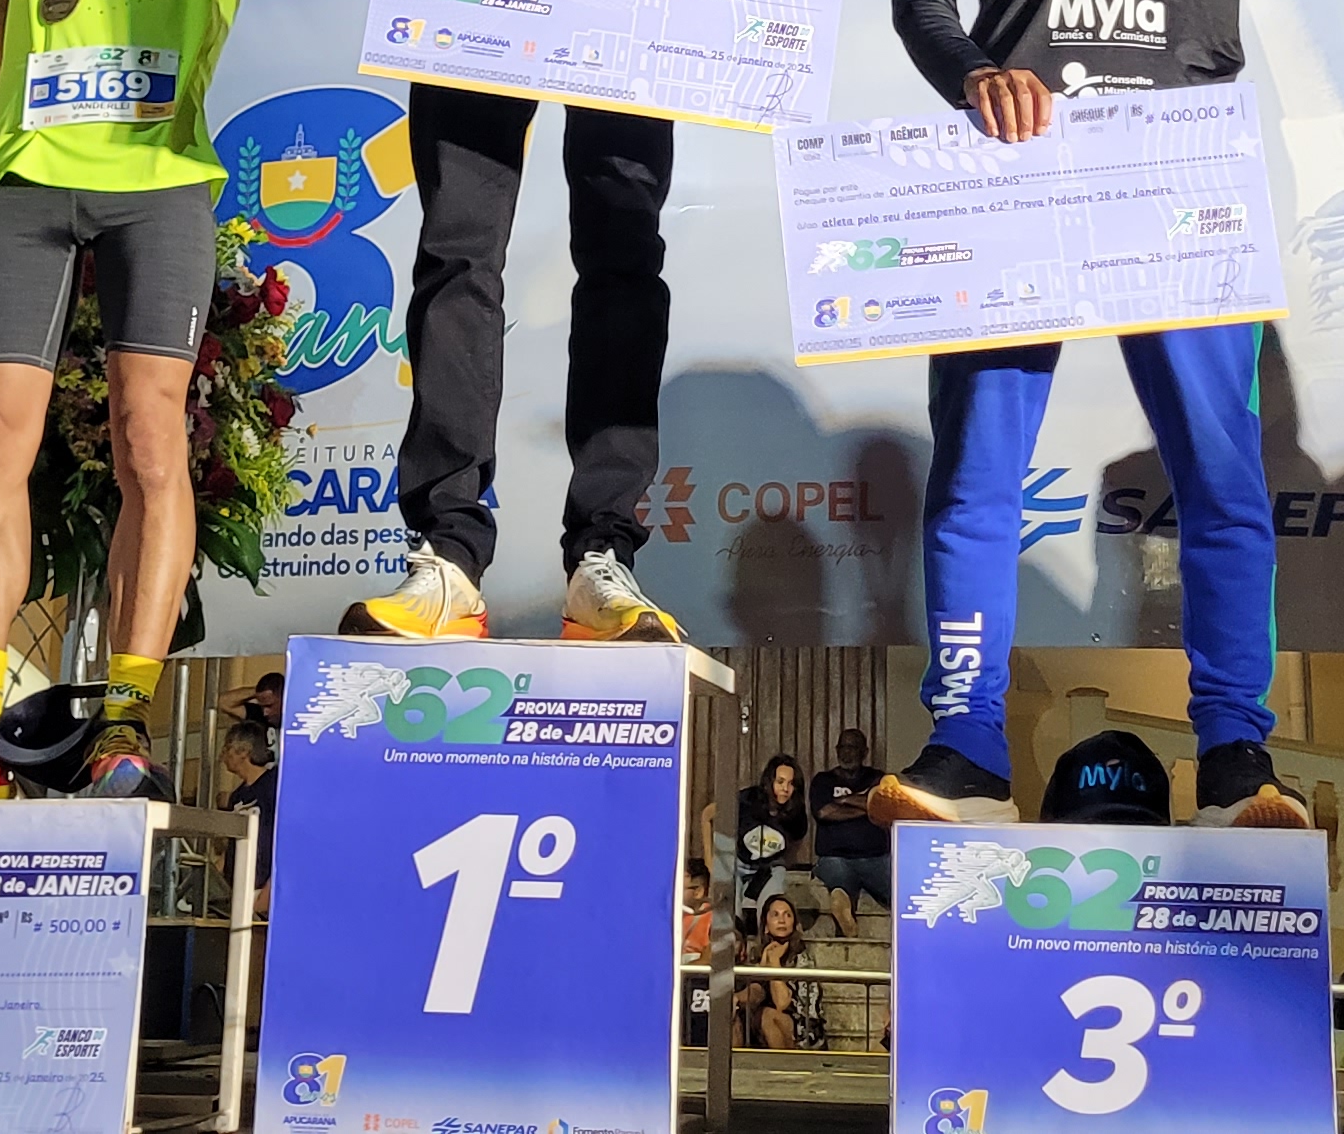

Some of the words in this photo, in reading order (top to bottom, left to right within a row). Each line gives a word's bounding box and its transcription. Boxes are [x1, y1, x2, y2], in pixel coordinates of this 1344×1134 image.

[505, 0, 550, 14] JANEIRO
[767, 22, 799, 36] BANCO
[1052, 29, 1084, 40] Bonés
[1085, 32, 1093, 40] e
[1113, 30, 1167, 44] Camisetas
[457, 33, 511, 48] APUCARANA
[764, 36, 807, 51] ESPORTE
[647, 41, 706, 59] Apucarana,
[711, 50, 725, 60] 25
[737, 54, 773, 68] janeiro
[56, 70, 150, 101] 5169
[1104, 75, 1153, 85] Conselho
[72, 102, 130, 110] VANDERLEI
[1160, 106, 1219, 124] 400,00
[797, 137, 824, 150] COMP
[841, 133, 871, 146] BANCO
[890, 126, 928, 141] AGÊNCIA
[889, 179, 983, 197] QUATROCENTOS
[822, 218, 854, 229] atleta
[858, 214, 879, 227] pelo
[883, 213, 900, 223] seu
[904, 207, 967, 221] desempenho
[971, 204, 985, 214] na
[1014, 200, 1045, 210] Prova
[1049, 193, 1093, 207] Pedestre
[1115, 188, 1128, 199] de
[1198, 206, 1231, 222] BANCO
[1200, 219, 1242, 235] ESPORTE
[925, 250, 972, 263] JANEIRO
[1148, 252, 1162, 263] 25
[885, 295, 941, 309] APUCARANA
[718, 481, 884, 523] COPEL
[321, 523, 358, 545] das
[356, 560, 370, 573] o
[384, 666, 532, 744] 62ª
[514, 702, 566, 715] PROVA
[568, 702, 644, 717] PEDESTRE
[506, 722, 538, 742] 28
[539, 724, 563, 740] de
[565, 722, 675, 744] JANEIRO
[384, 748, 407, 763] Um
[410, 752, 444, 764] novo
[446, 751, 509, 765] momento
[512, 754, 528, 765] na
[532, 752, 580, 766] história
[582, 753, 600, 766] de
[602, 753, 673, 769] Apucarana
[31, 856, 103, 869] PEDESTRE
[2, 880, 26, 894] de
[27, 875, 134, 896] JANEIRO
[1006, 847, 1161, 931] 62ª
[1144, 886, 1199, 900] PROVA
[1202, 888, 1282, 902] PEDESTRE
[413, 813, 577, 1014] 1º
[1136, 907, 1170, 929] 28
[1172, 909, 1196, 927] de
[1199, 909, 1319, 934] JANEIRO
[49, 918, 106, 935] 500,00
[1008, 935, 1033, 950] Um
[1036, 939, 1070, 951] novo
[1073, 939, 1142, 953] momento
[1144, 941, 1161, 953] na
[1165, 940, 1217, 956] história
[1220, 942, 1238, 956] de
[1242, 942, 1319, 959] Apucarana
[57, 1030, 90, 1042] BANCO
[55, 1044, 101, 1058] ESPORTE
[1042, 975, 1202, 1114] 3º
[282, 1053, 347, 1107] 81
[283, 1115, 337, 1127] APUCARANA
[385, 1118, 421, 1130] COPEL
[462, 1122, 537, 1134] SANEPAR
